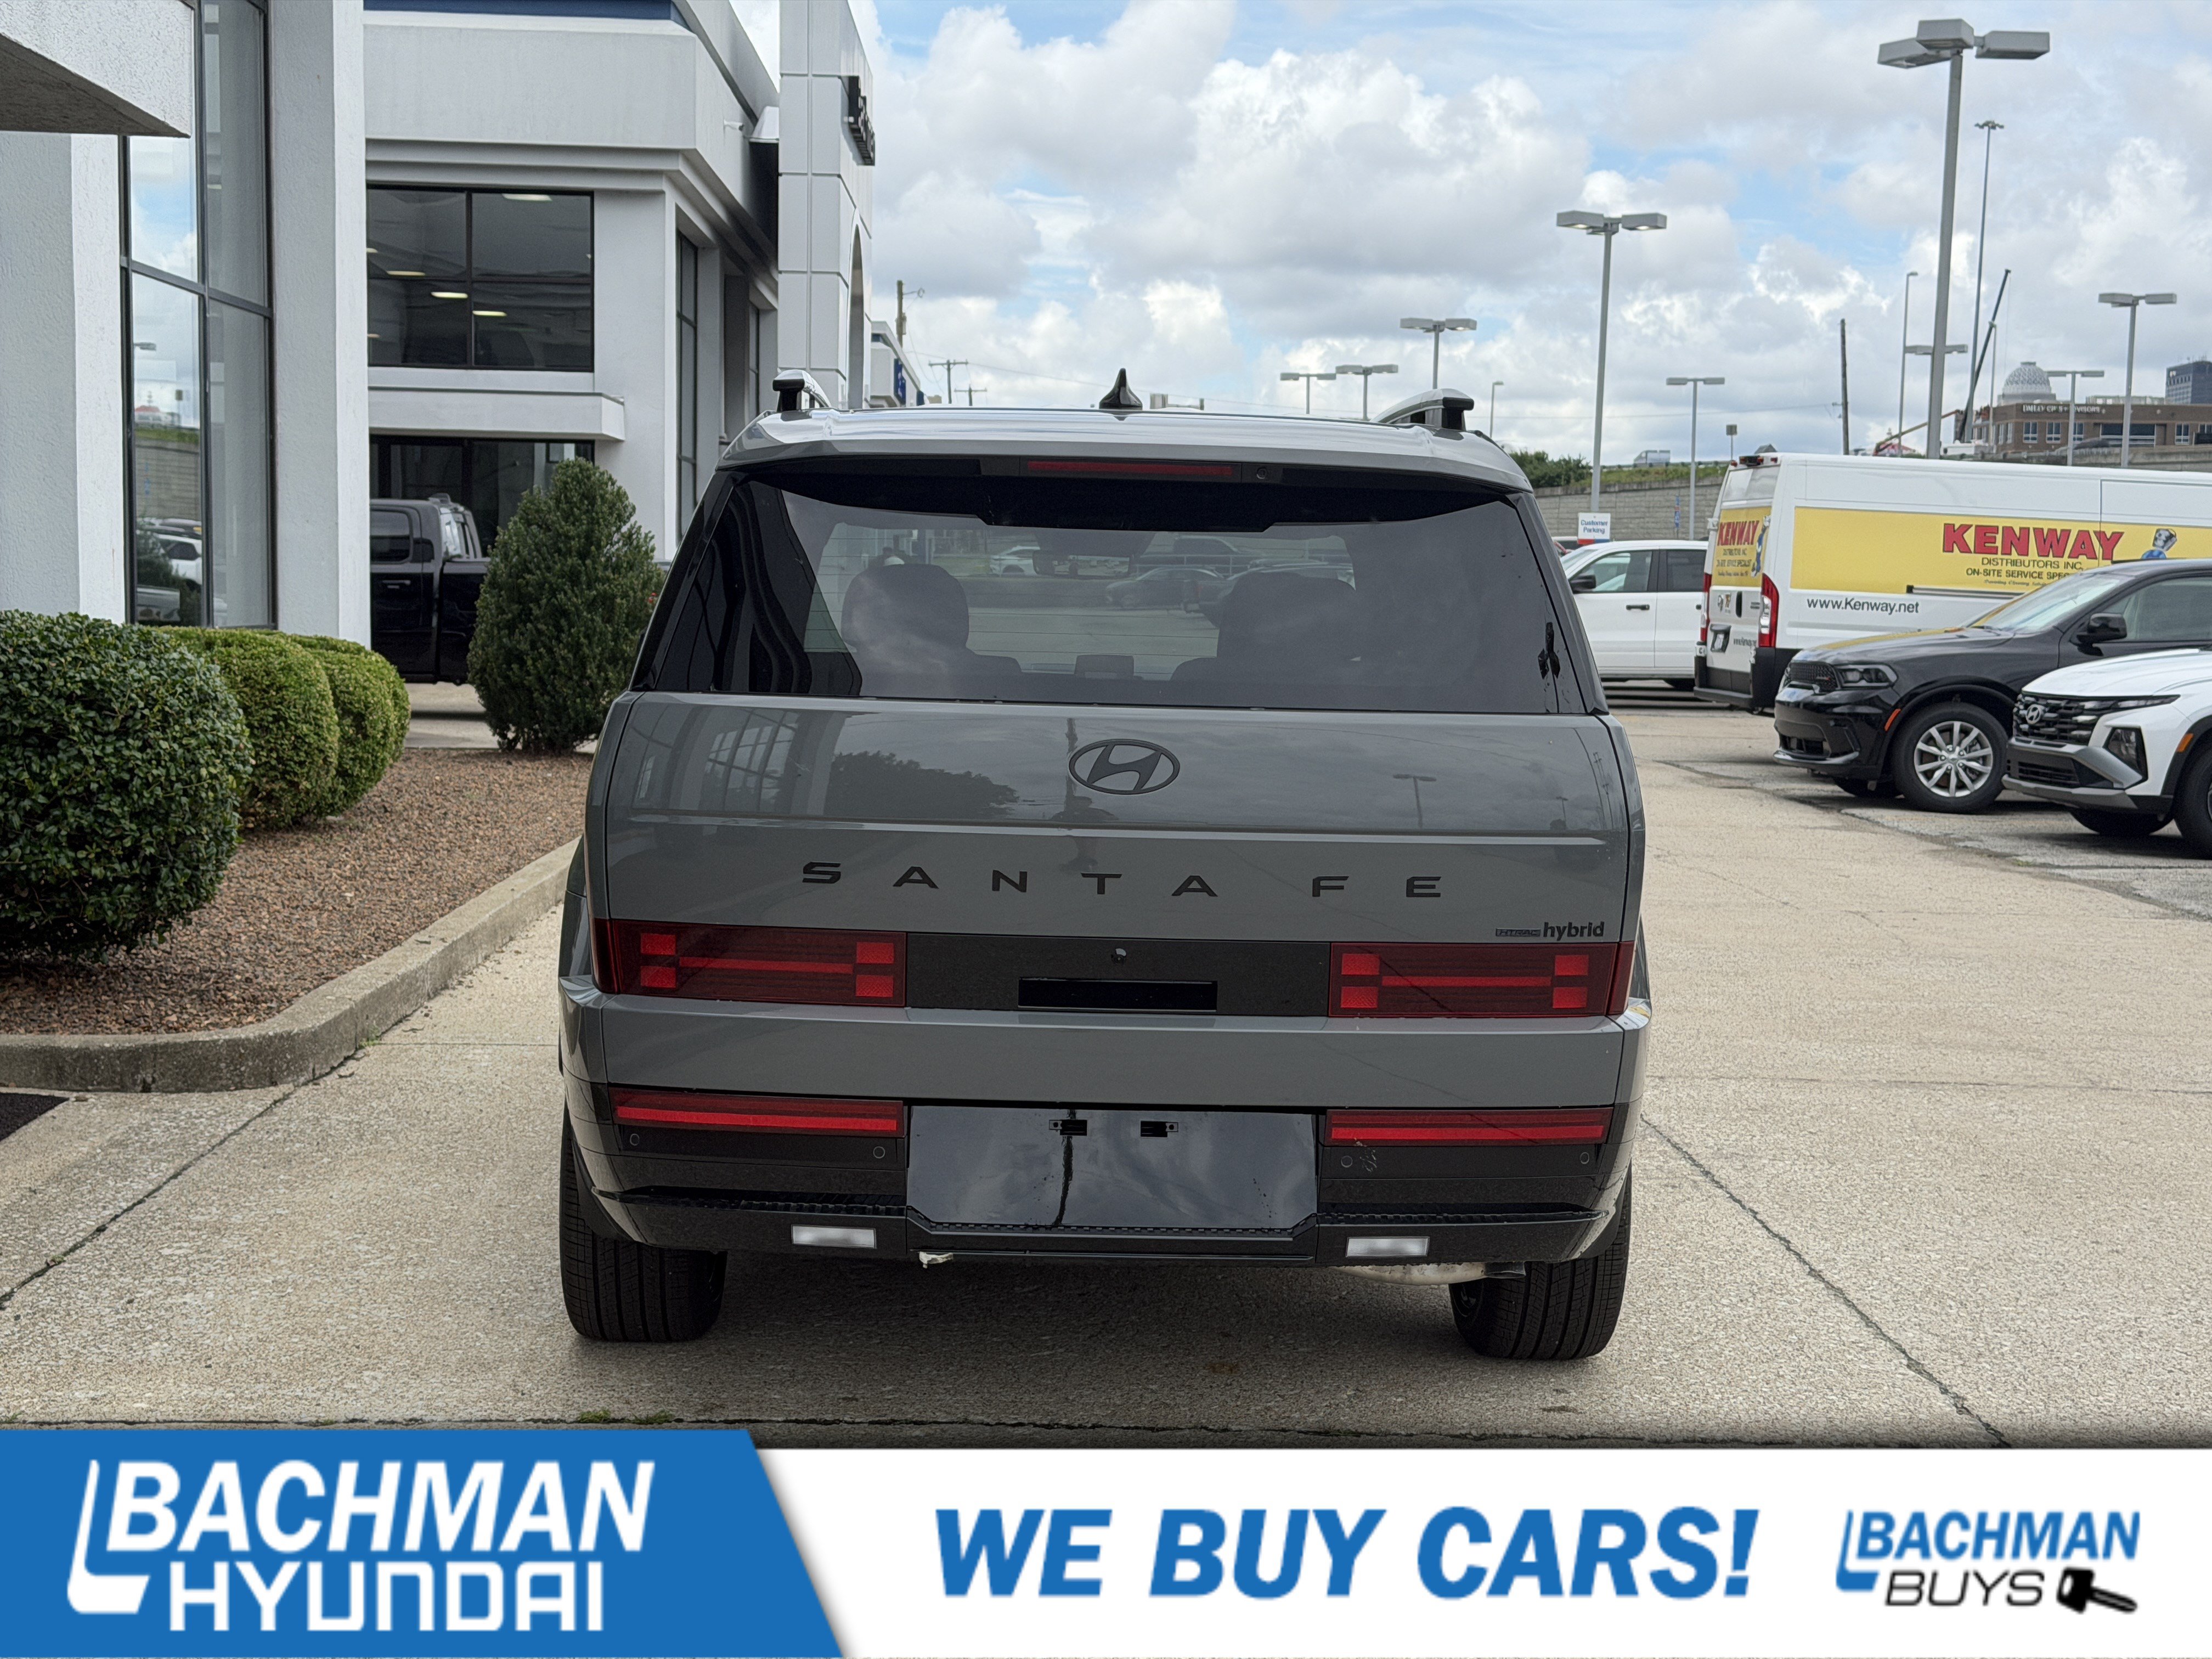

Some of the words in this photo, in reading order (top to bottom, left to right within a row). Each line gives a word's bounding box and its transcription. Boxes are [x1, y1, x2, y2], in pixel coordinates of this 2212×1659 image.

[1583, 526, 1605, 534] Parking
[1717, 520, 1760, 546] KENWAY
[1943, 523, 2124, 561] KENWAY
[1981, 557, 2059, 569] DISTRIBUTORS
[1966, 567, 2002, 578] ON-SITE
[2005, 569, 2044, 580] SERVICE
[1807, 597, 1919, 615] www.Kenway.net
[802, 861, 1218, 897] SANTA
[1312, 876, 1442, 898] FE
[1543, 921, 1605, 941] hybrid
